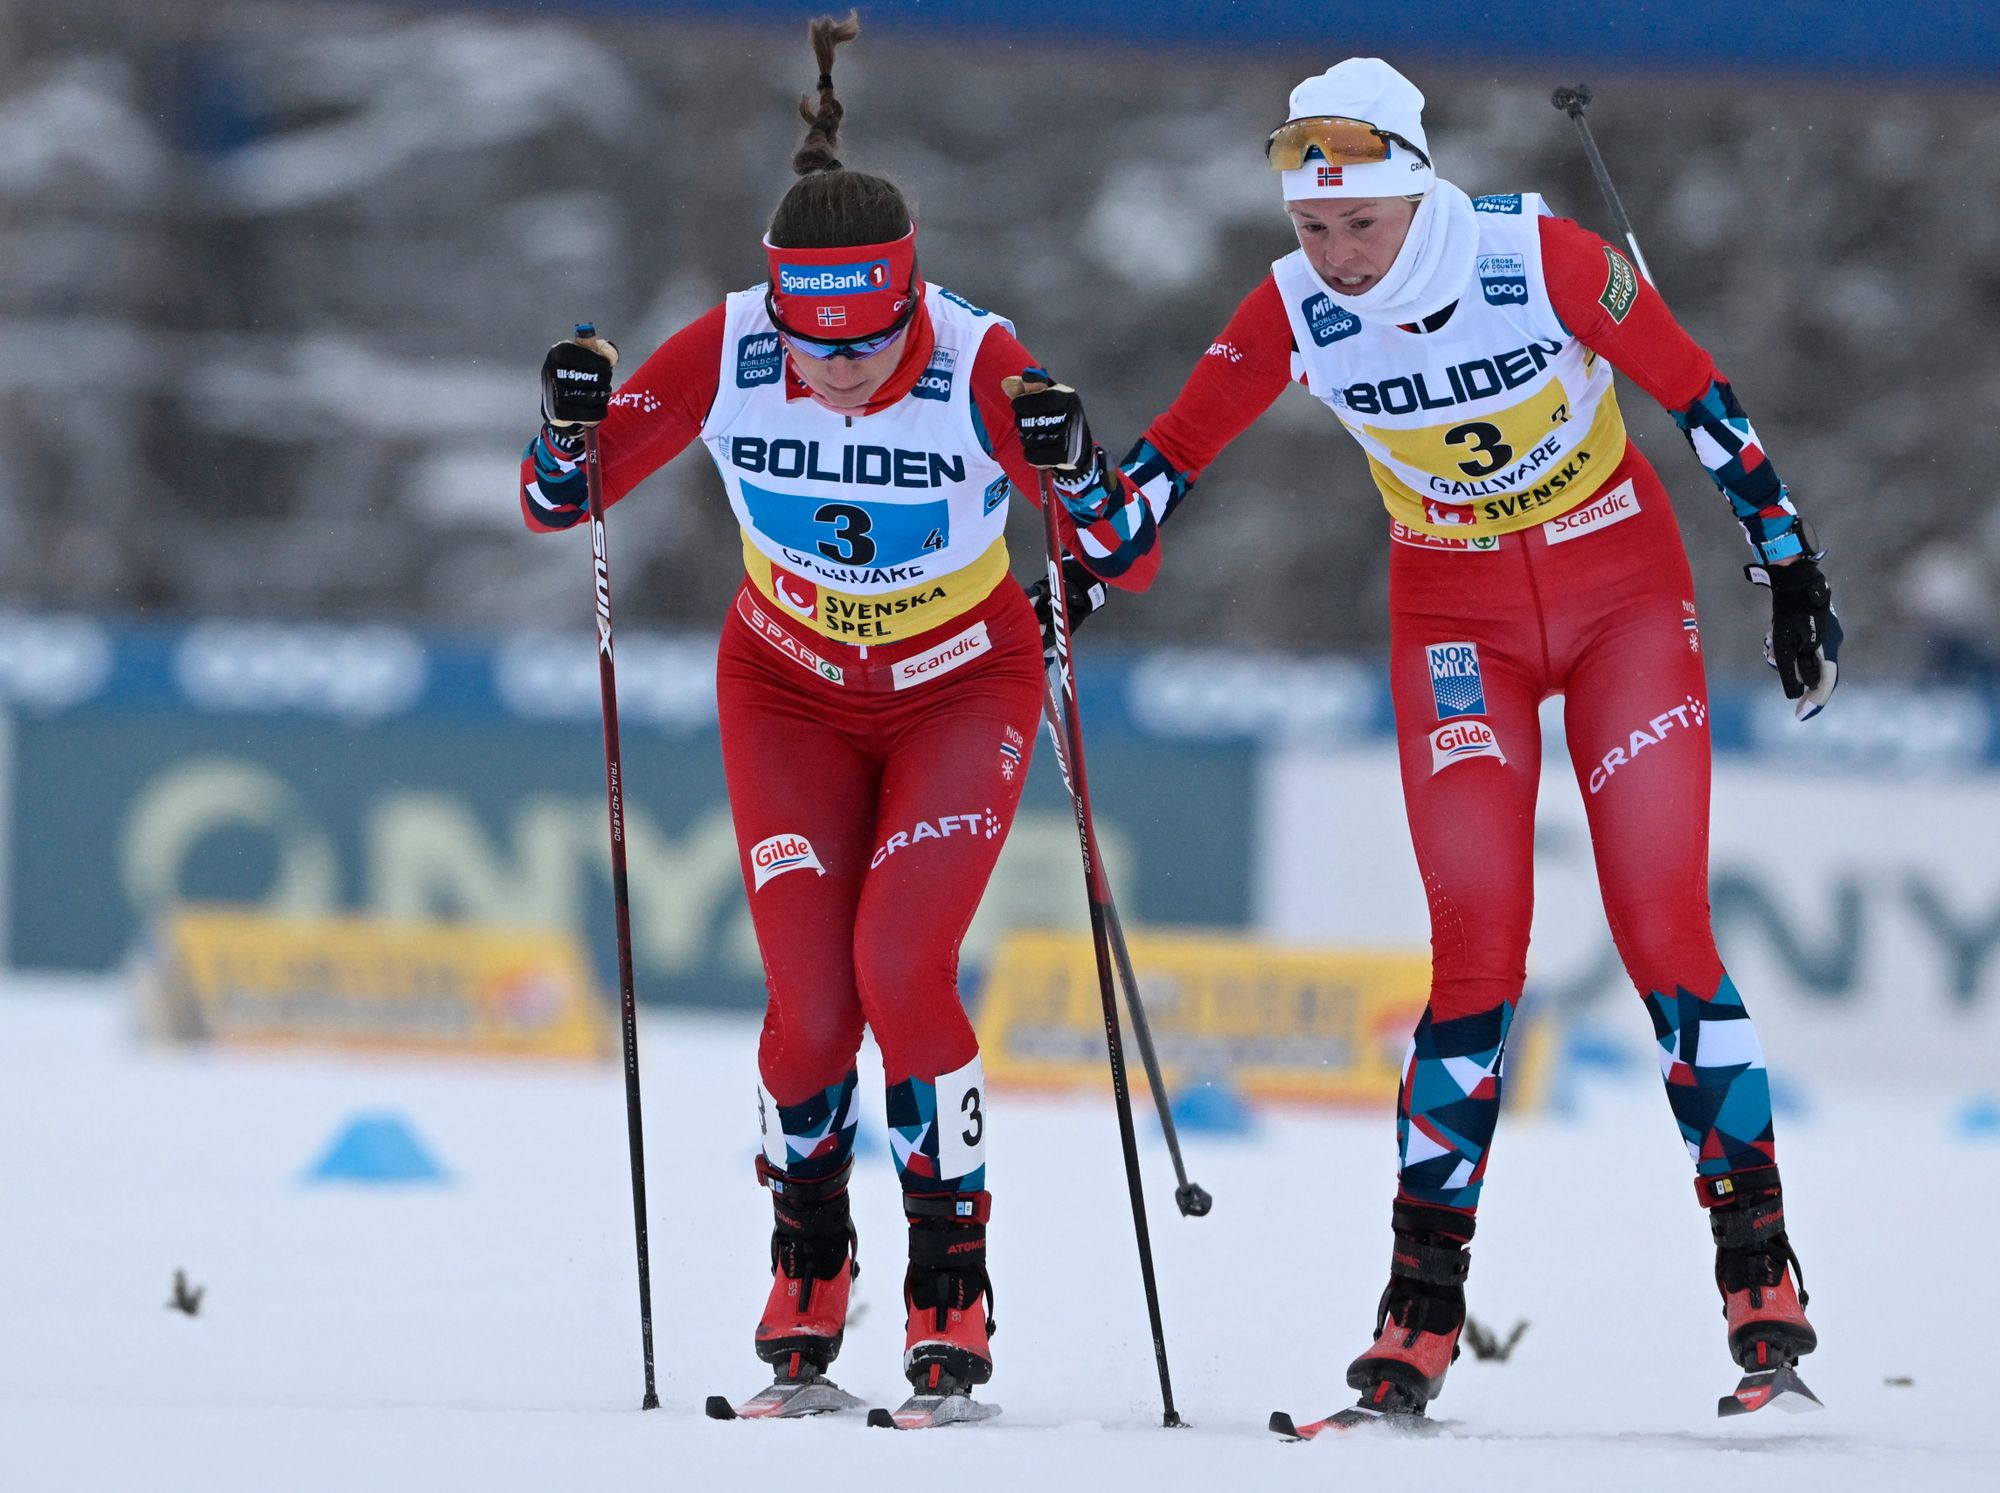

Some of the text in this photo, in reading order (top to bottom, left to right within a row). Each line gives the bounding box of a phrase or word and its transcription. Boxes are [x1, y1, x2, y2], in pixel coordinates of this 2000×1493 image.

[781, 267, 883, 292] SpareBank 1
[1486, 283, 1525, 298] coop
[1311, 313, 1337, 328] WORLD
[1320, 319, 1352, 338] coop
[740, 358, 765, 367] WORLD
[1343, 340, 1563, 415] BOLIDEN
[732, 436, 966, 489] BOLIDEN
[1445, 421, 1513, 477] 3
[987, 475, 1011, 509] 3
[1485, 450, 1591, 521] SVENSKA
[1552, 493, 1630, 533] Scandic
[813, 502, 877, 566] 3
[922, 528, 945, 551] 4
[825, 586, 947, 620] SVENSKA
[751, 608, 817, 668] SPAR
[826, 614, 891, 637] SPEL
[903, 634, 981, 679] Scandic
[1431, 646, 1475, 665] NOR
[1432, 660, 1479, 680] MILK
[1006, 725, 1024, 749] NOR
[1435, 726, 1492, 751] Gilde
[1589, 704, 1690, 794] CRAFT
[610, 761, 619, 793] TRIAC
[613, 811, 621, 842] AERO
[870, 813, 982, 870] CRAFT
[755, 838, 809, 868] Gilde
[960, 1087, 984, 1147] 3
